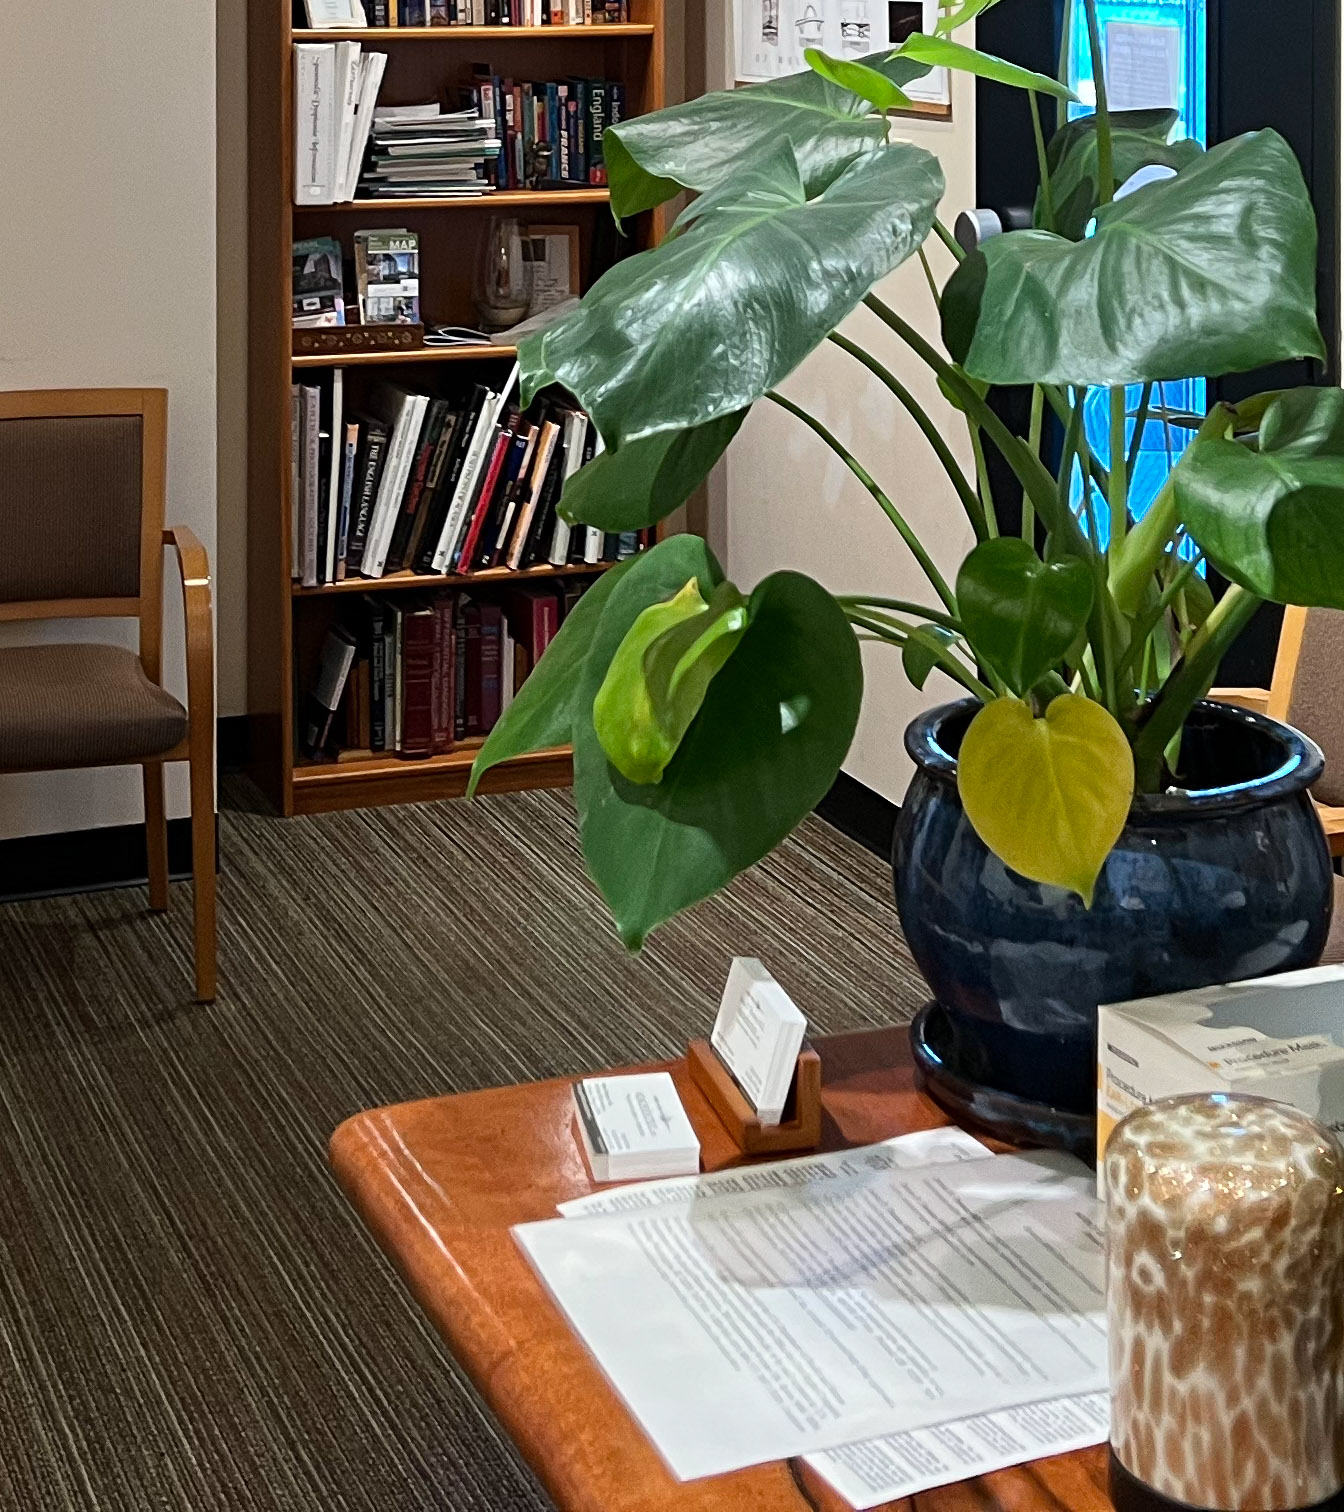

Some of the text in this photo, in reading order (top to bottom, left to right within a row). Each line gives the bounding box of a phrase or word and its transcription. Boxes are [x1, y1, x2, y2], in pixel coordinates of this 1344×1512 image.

[590, 90, 605, 140] England
[611, 102, 620, 124] Indo
[389, 240, 416, 250] MAP
[355, 445, 379, 537] THE ENGLISH LANGUAGE
